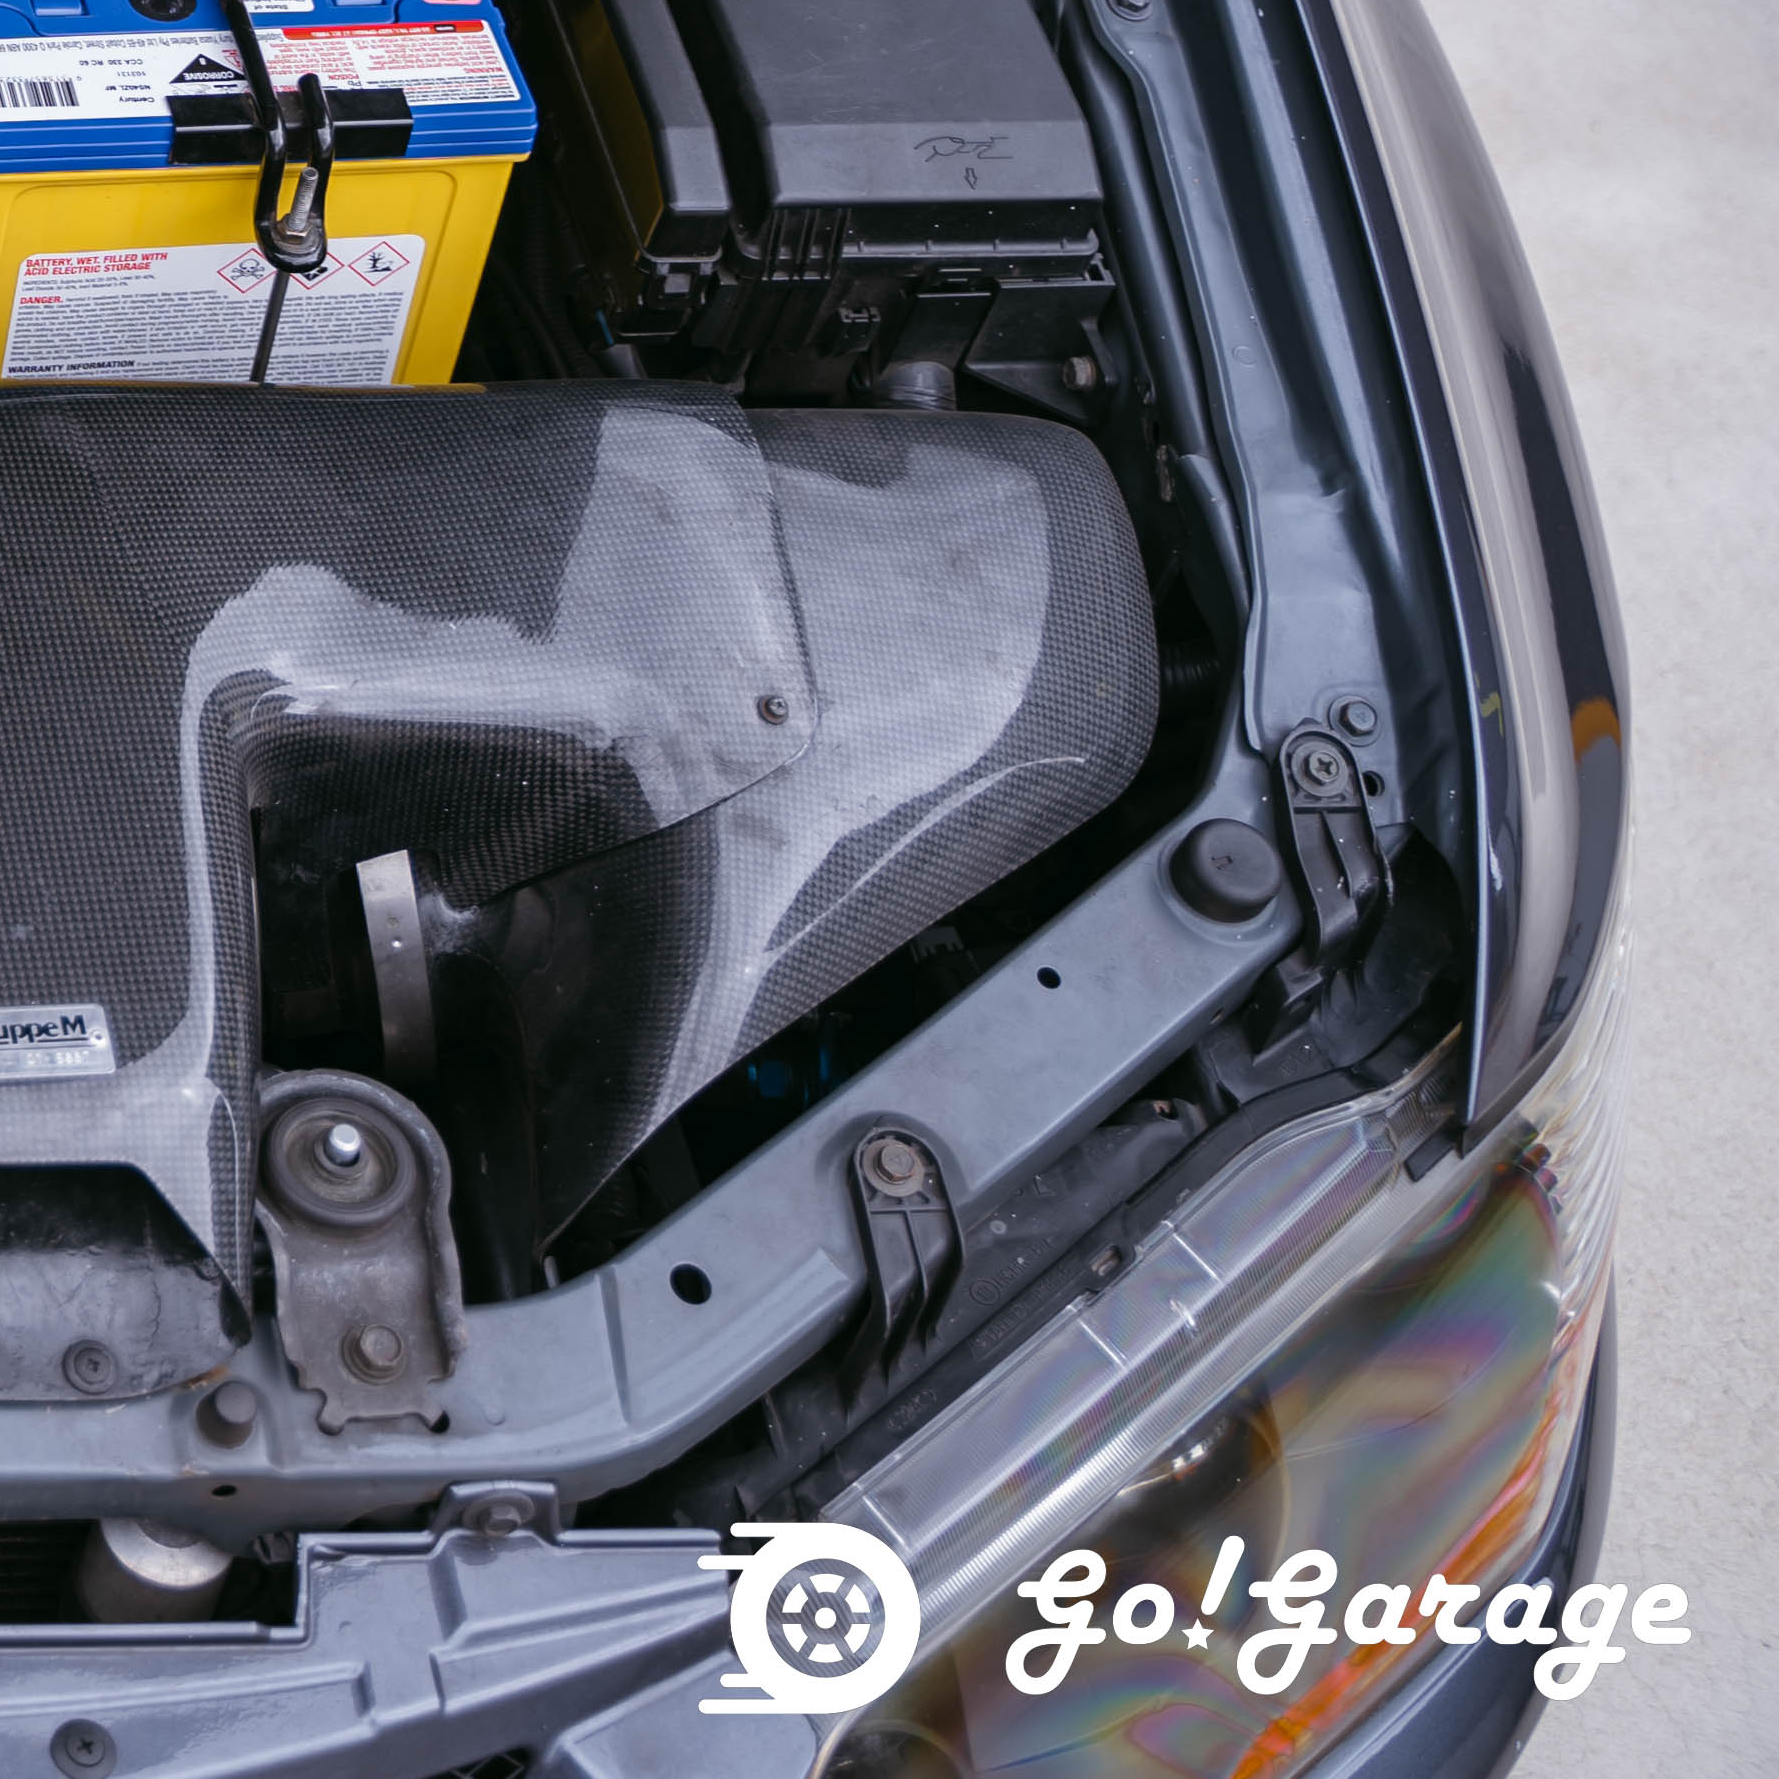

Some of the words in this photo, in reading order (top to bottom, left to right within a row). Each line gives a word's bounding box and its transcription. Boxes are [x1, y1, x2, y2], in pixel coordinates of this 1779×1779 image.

[106, 39, 127, 48] Cobalt
[147, 38, 159, 47] Ltd
[159, 37, 170, 47] Pty
[170, 36, 198, 46] Batteries
[47, 42, 61, 51] Park
[463, 66, 504, 74] WARNING
[183, 70, 235, 81] CORROSIVE
[328, 73, 359, 81] POISON
[103, 254, 138, 263] FILLED
[141, 252, 168, 261] WITH
[24, 267, 49, 276] ACID
[52, 264, 101, 275] ELECTRIC
[103, 262, 151, 272] STORAGE
[19, 295, 64, 305] DANGER.
[8, 364, 64, 373] WARRANTY
[66, 360, 135, 371] INFORMATION
